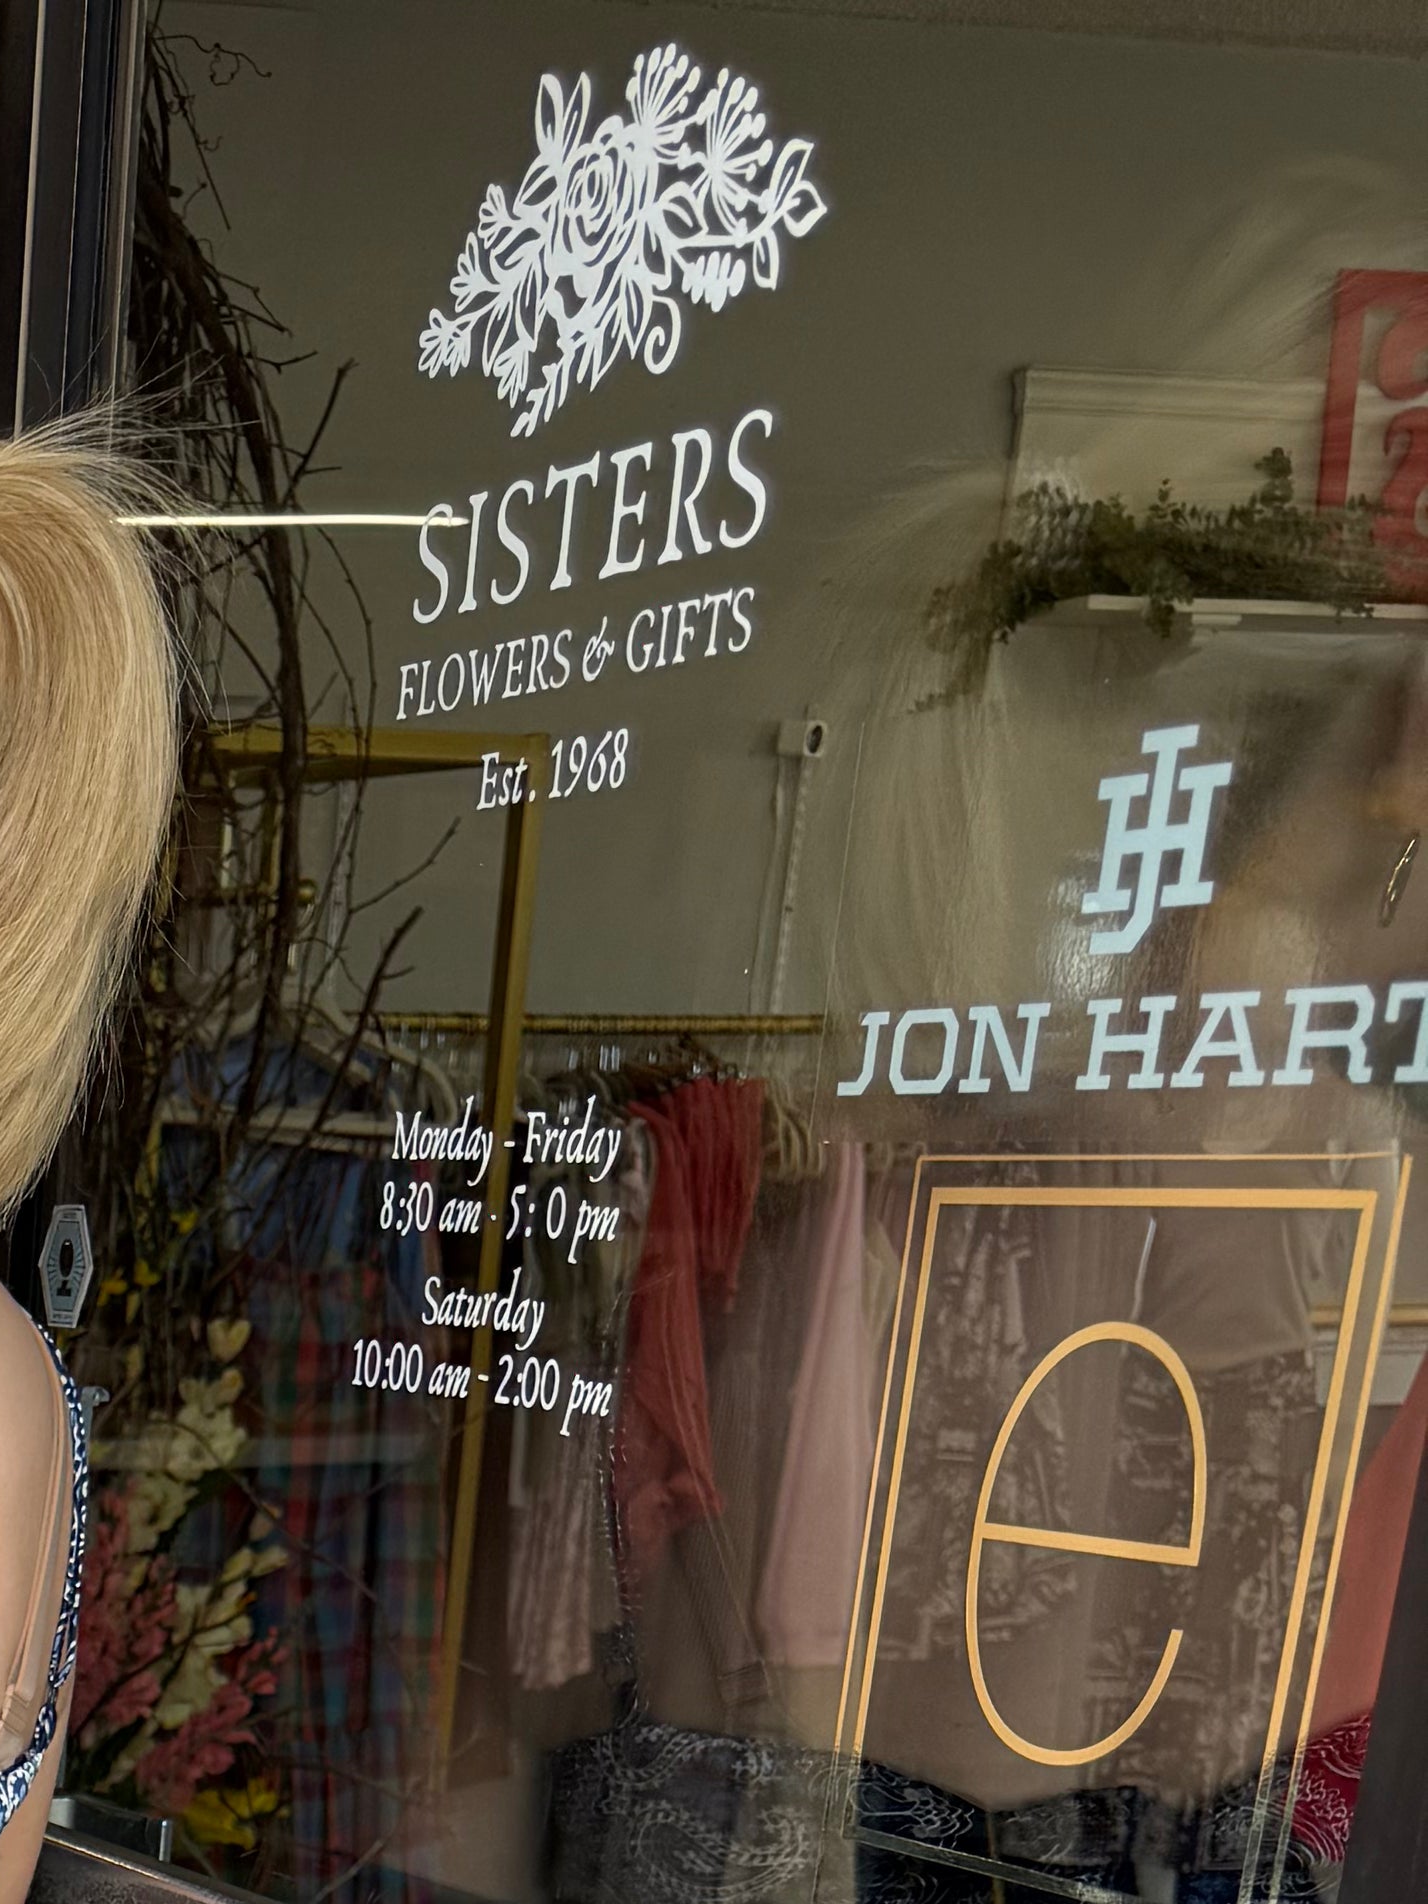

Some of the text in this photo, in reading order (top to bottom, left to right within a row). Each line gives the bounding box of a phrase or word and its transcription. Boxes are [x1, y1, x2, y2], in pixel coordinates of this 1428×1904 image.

[412, 408, 774, 624] SISTERS
[396, 629, 573, 721] FLOWERS
[626, 587, 756, 673] GIFTS
[476, 728, 630, 811] Est. 1968
[836, 1003, 1052, 1096] JON
[391, 1095, 494, 1187] Monday
[522, 1095, 622, 1183] Friday
[379, 1181, 434, 1237] 8:30
[438, 1197, 482, 1234] am
[567, 1200, 621, 1264] pm
[422, 1266, 545, 1351] Saturday
[352, 1338, 424, 1393] 10:00
[428, 1361, 471, 1399] am
[494, 1353, 560, 1410] 2:00
[559, 1373, 614, 1437] pm
[967, 1321, 1209, 1767] e
